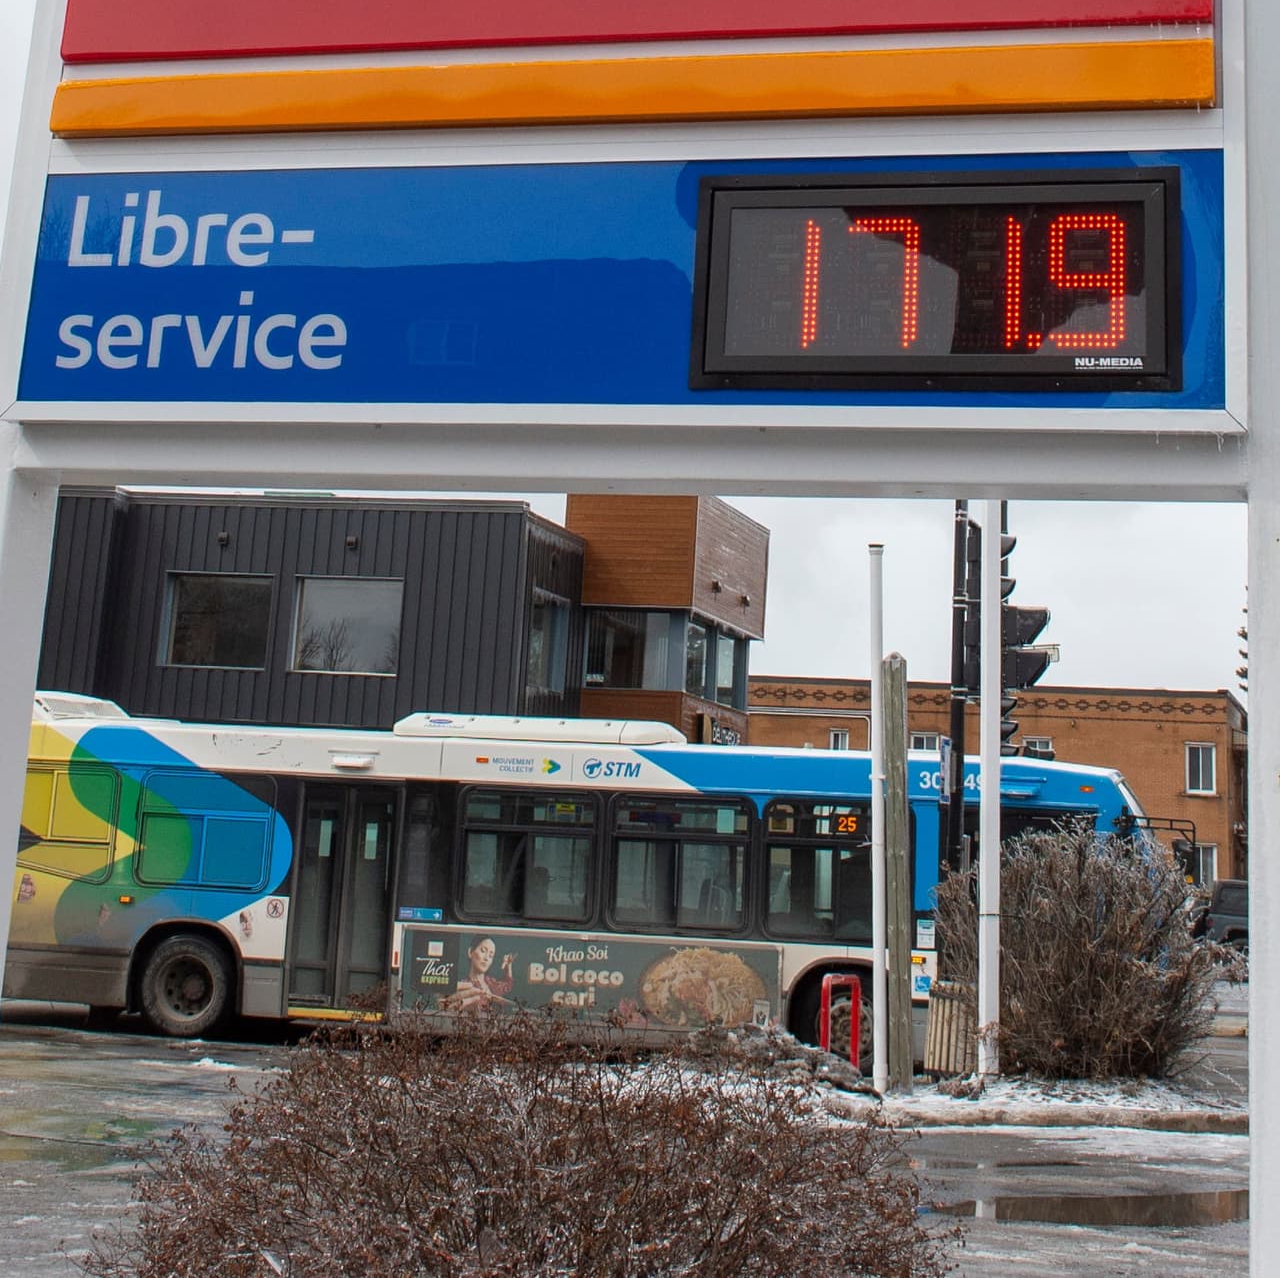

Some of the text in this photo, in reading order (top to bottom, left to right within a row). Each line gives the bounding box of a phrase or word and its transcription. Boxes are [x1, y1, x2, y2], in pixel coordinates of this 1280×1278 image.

[68, 190, 315, 268] Libre-
[799, 214, 1126, 350] 171.9
[56, 290, 347, 371] service
[1074, 357, 1144, 367] NU-MEDIA
[492, 757, 534, 765] MOUVEMENT
[603, 761, 642, 778] STM
[838, 816, 857, 832] 25
[546, 945, 609, 963] Khao Soi
[416, 957, 454, 976] Thaï
[528, 962, 624, 986] Bol coco
[552, 986, 596, 1008] cari
